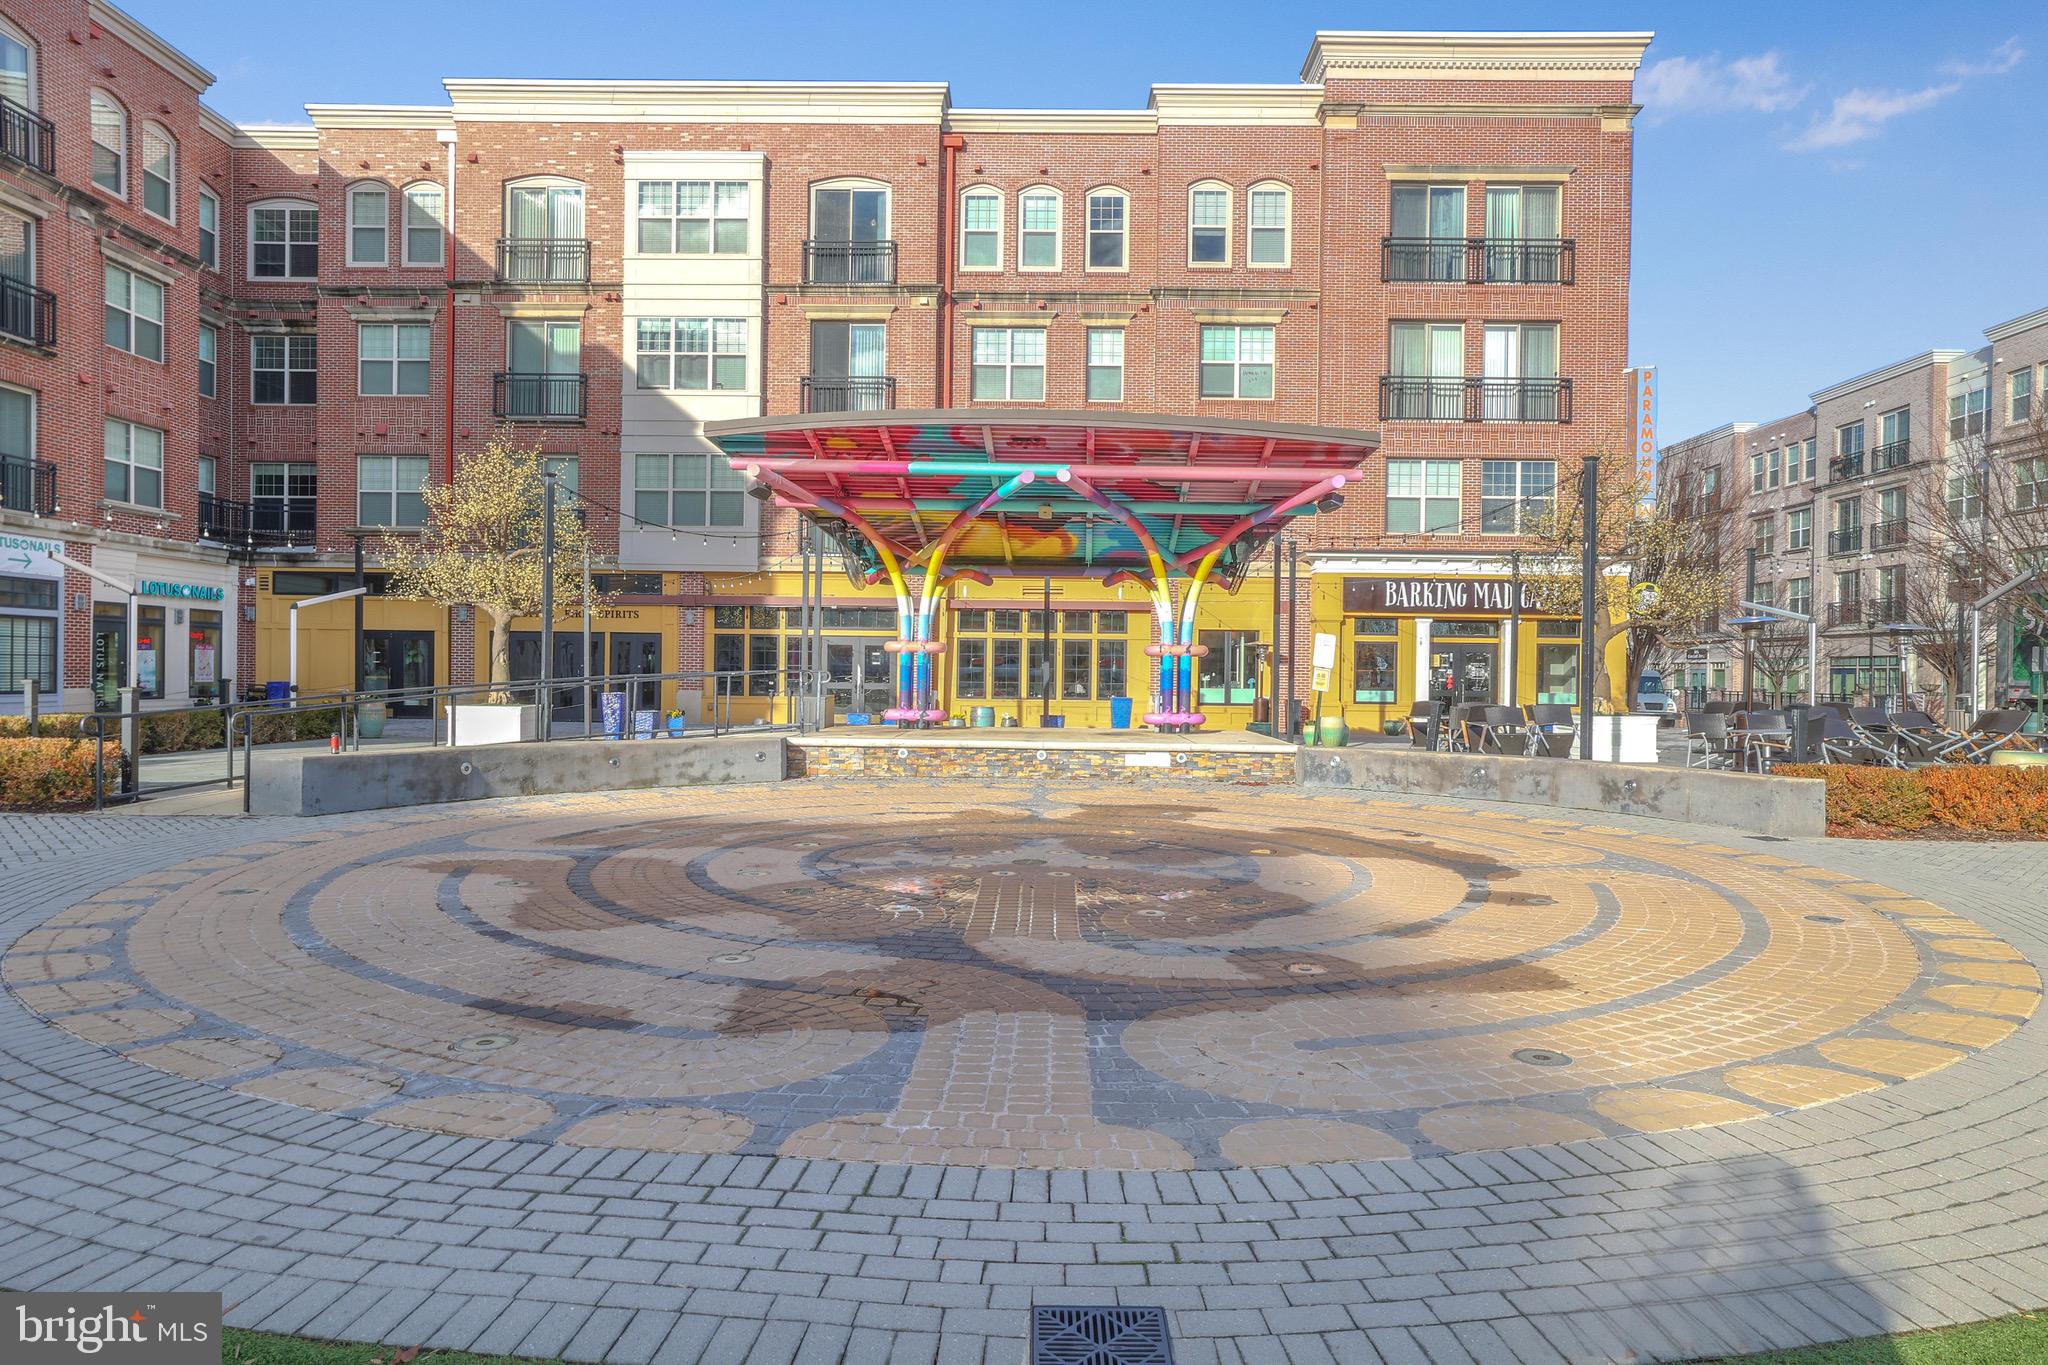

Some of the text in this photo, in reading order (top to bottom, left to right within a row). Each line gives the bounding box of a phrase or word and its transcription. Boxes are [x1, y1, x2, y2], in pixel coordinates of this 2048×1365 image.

[141, 580, 225, 601] LOTUS NAILS
[1385, 580, 1467, 608] BARKING
[1473, 582, 1513, 609] MAD
[96, 632, 105, 707] LOTUS NAILS
